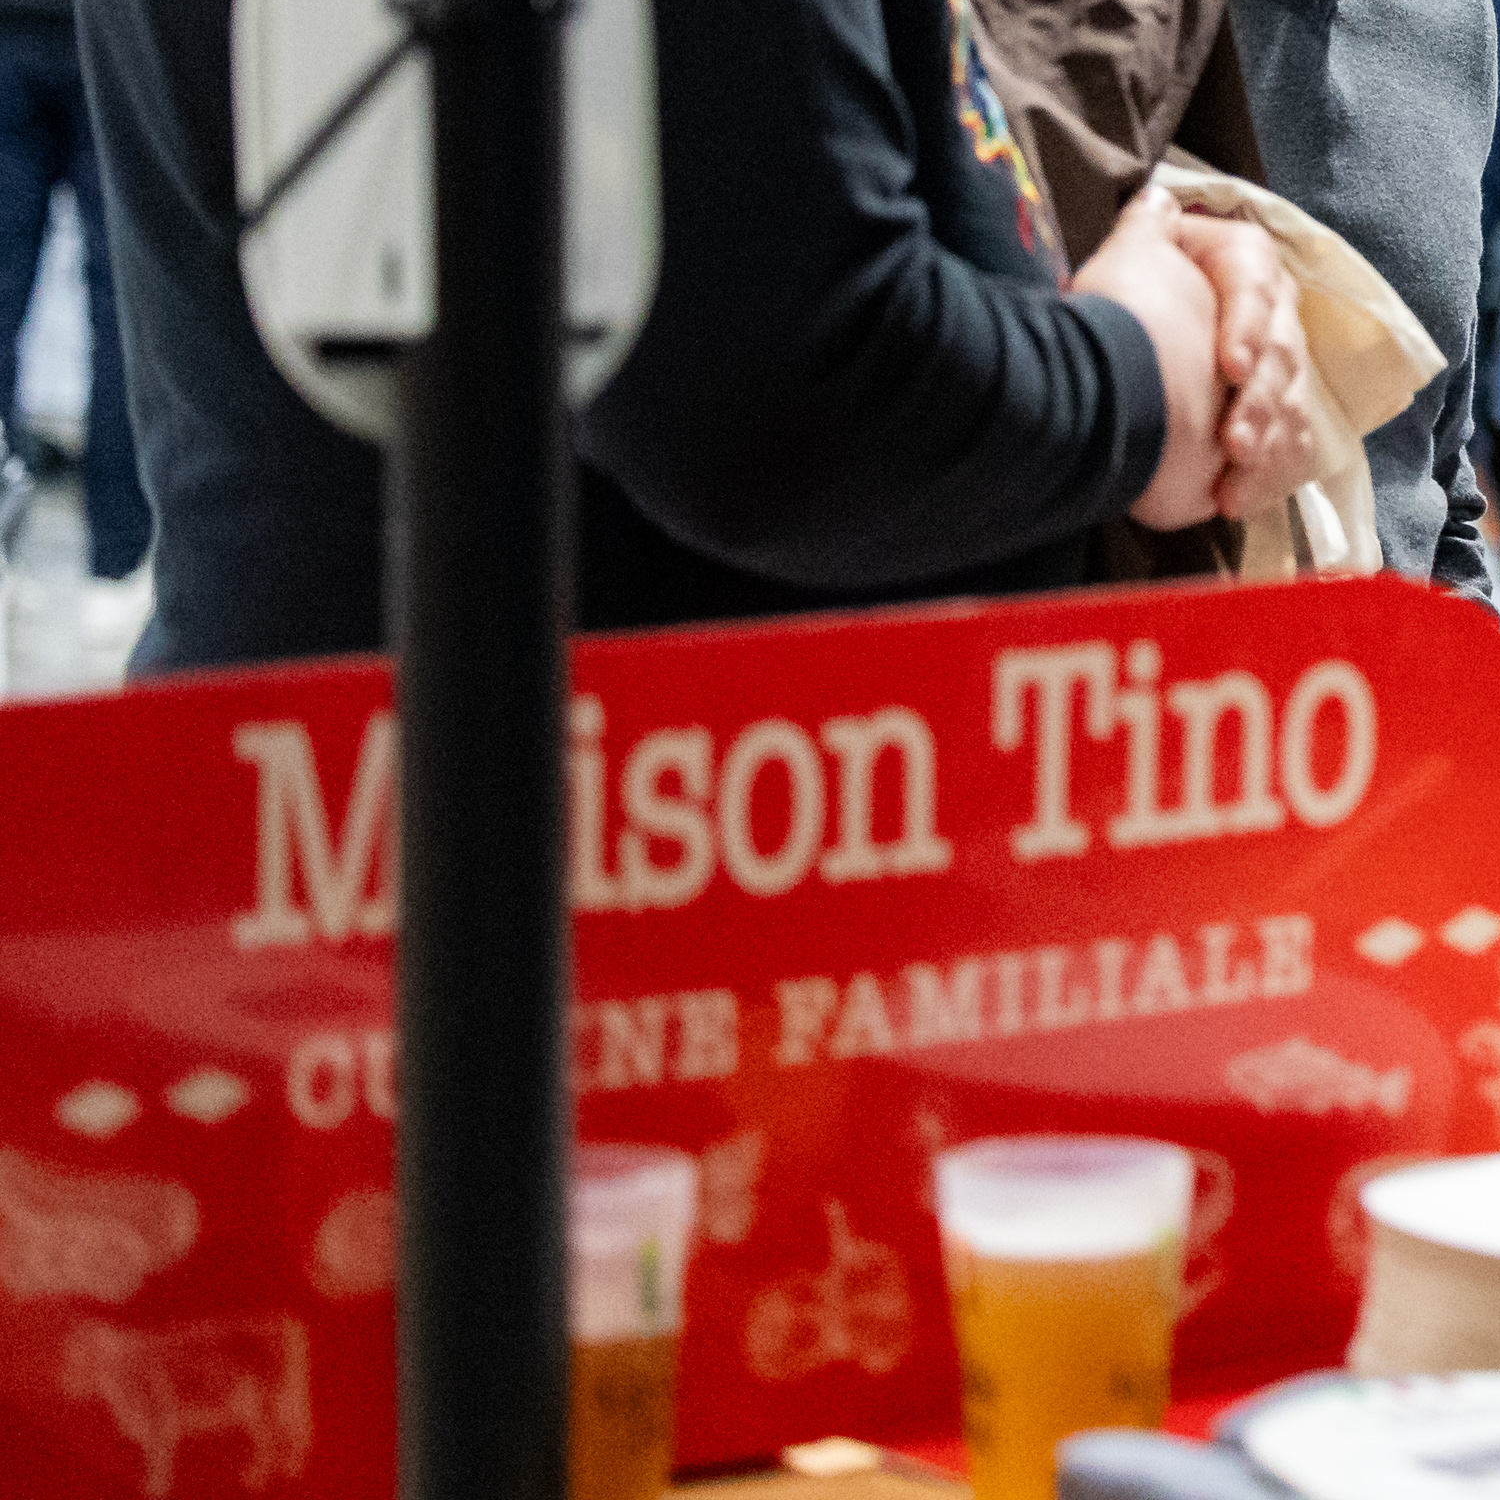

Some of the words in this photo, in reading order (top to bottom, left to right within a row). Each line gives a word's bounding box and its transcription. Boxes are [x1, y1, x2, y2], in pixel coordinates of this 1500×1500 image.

[232, 694, 953, 950] Mison
[991, 639, 1379, 860] Tino
[776, 913, 1317, 1066] FAMILIALE
